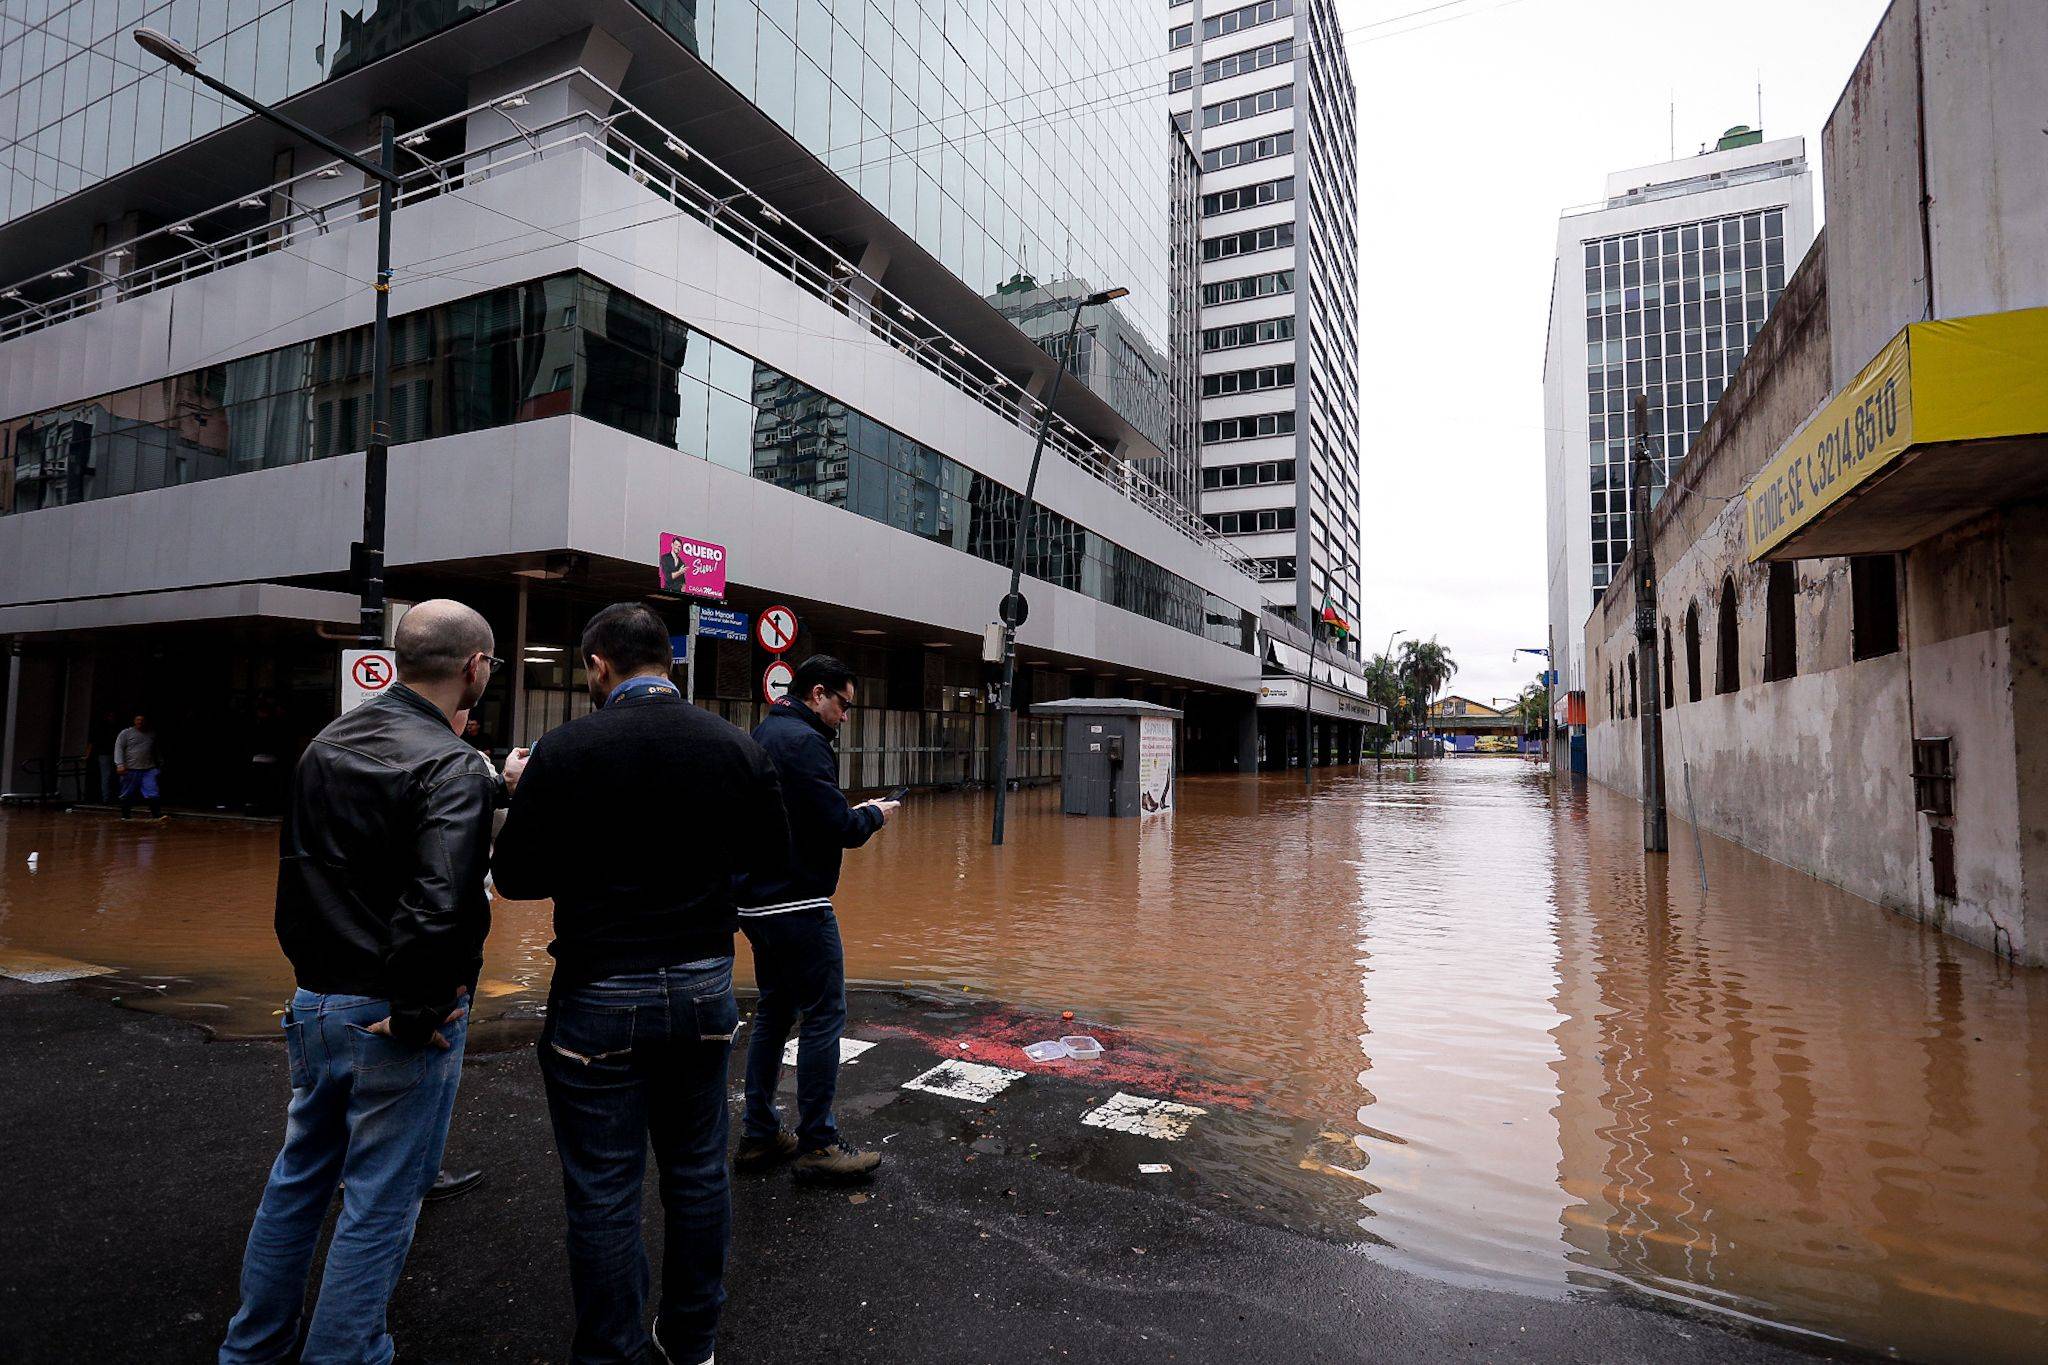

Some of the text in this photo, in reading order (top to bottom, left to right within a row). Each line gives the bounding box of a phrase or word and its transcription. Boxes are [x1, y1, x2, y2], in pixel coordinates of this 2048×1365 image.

[1752, 377, 1897, 545] VENDE-SE 3214.8510
[683, 543, 723, 561] QUERO
